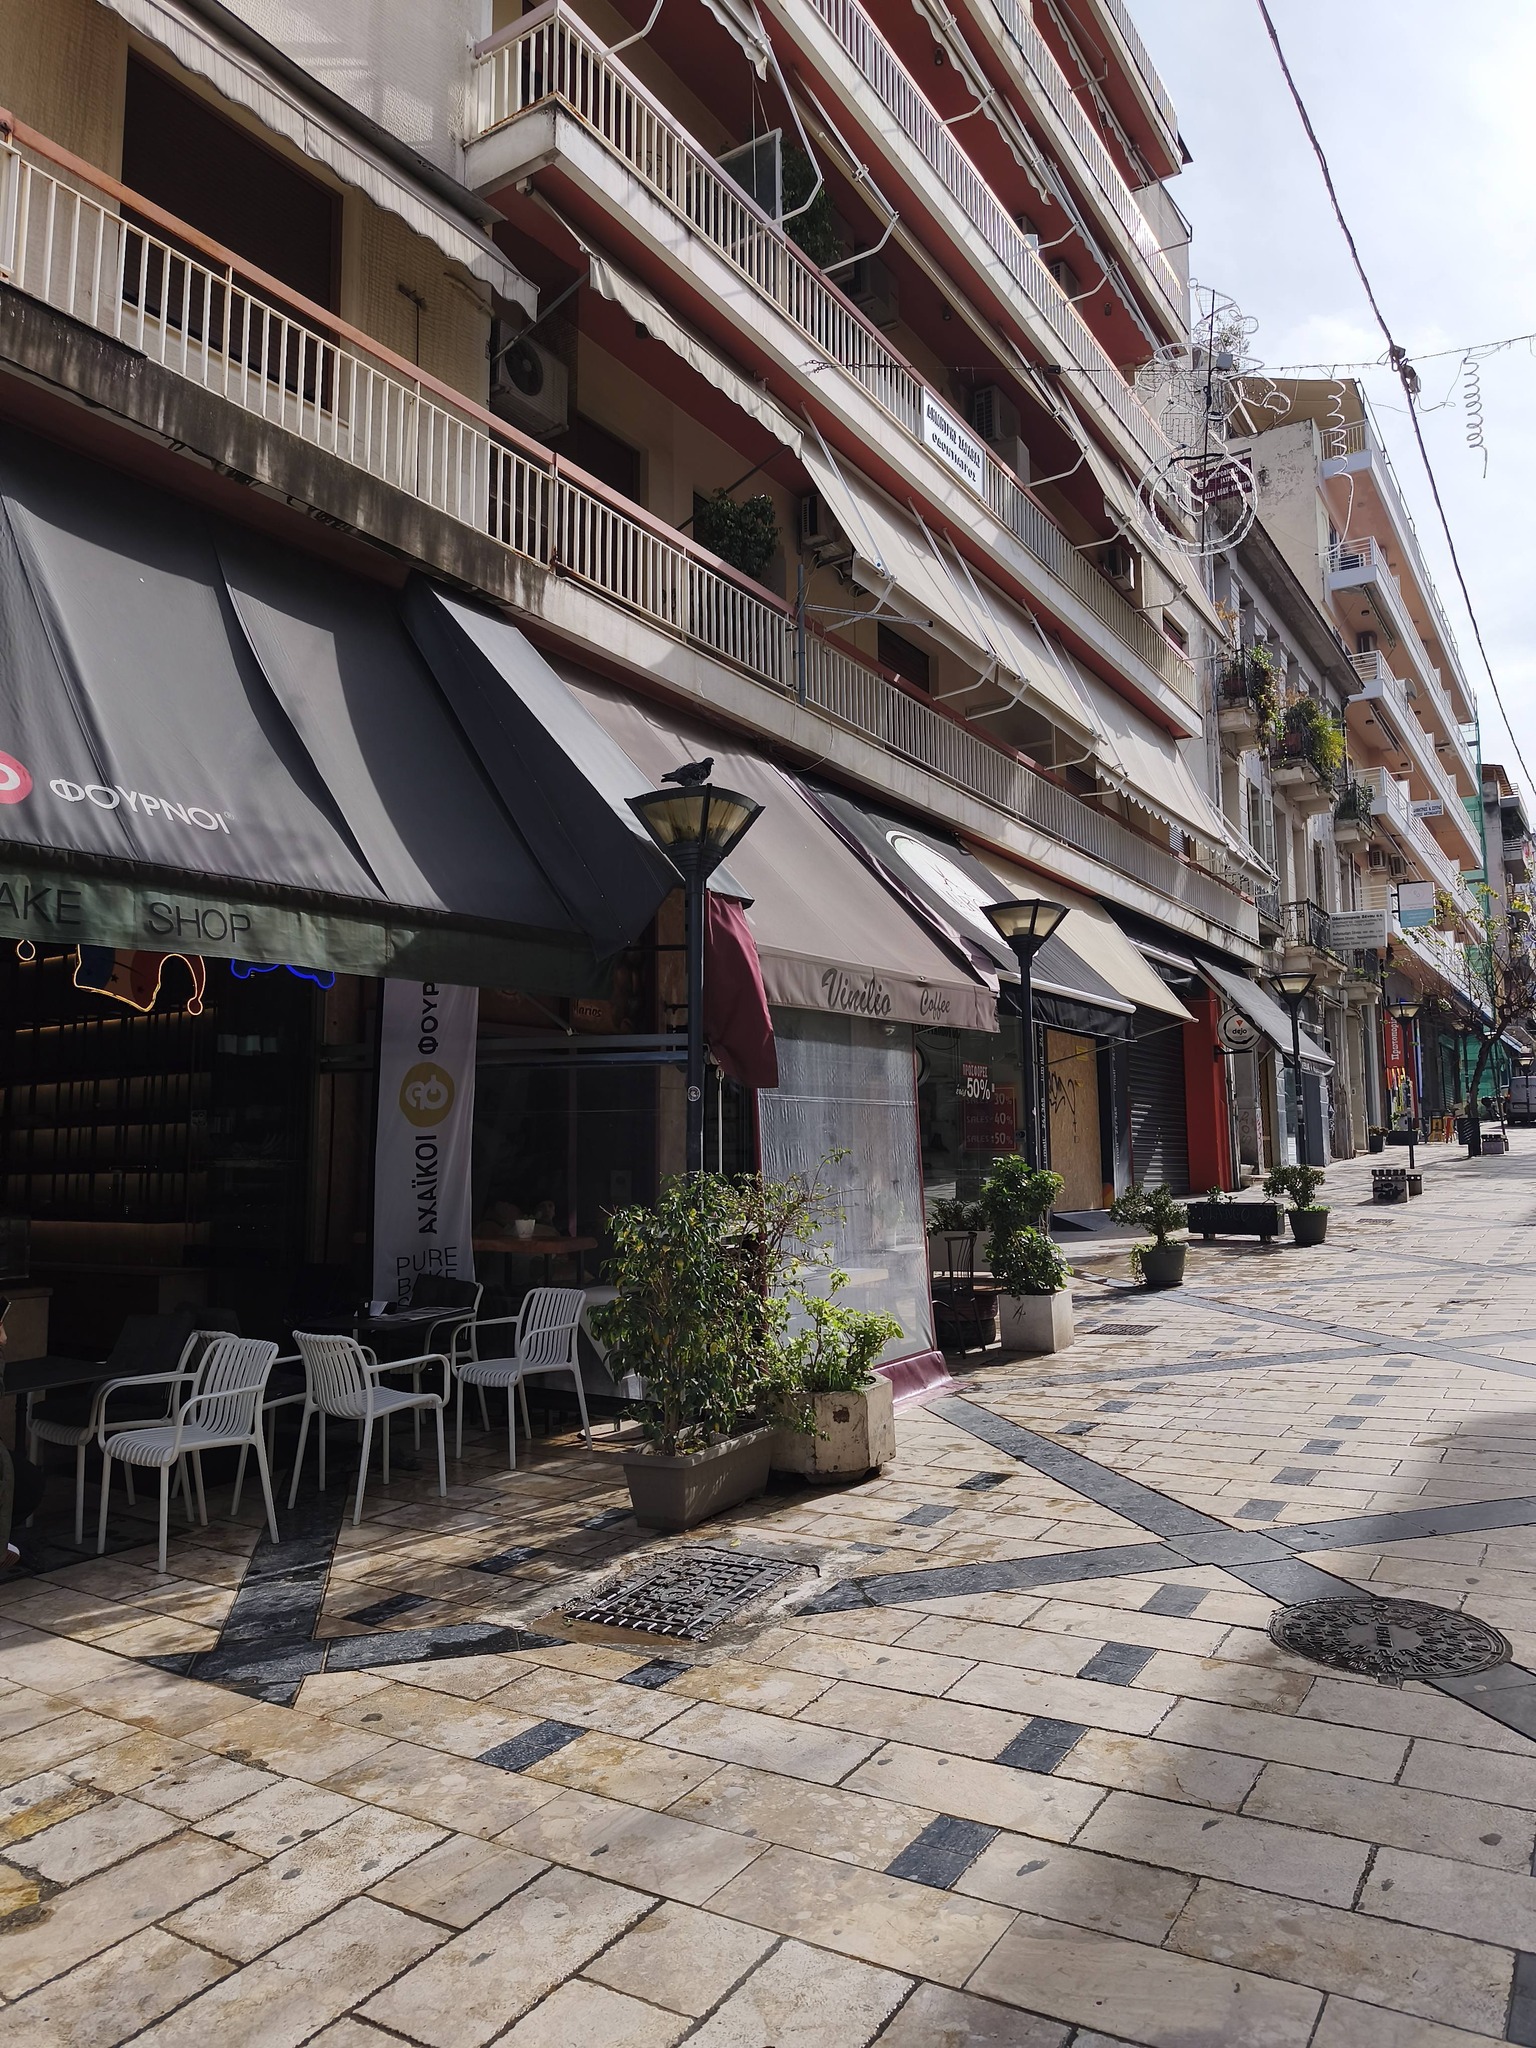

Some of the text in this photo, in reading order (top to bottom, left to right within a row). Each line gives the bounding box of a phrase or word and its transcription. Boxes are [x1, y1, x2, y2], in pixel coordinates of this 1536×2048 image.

[49, 779, 230, 834] ΦΟΥΡΝΟΙ
[148, 901, 250, 943] SHOP
[822, 968, 951, 1021] Vinilio Coffee
[1231, 1027, 1248, 1036] dejo
[966, 1077, 991, 1100] 50%
[994, 1112, 1013, 1126] 40%
[411, 1135, 438, 1234] ΑΧΑΪΚΟΙ
[396, 1246, 458, 1276] PURE
[398, 1268, 457, 1296] BE
